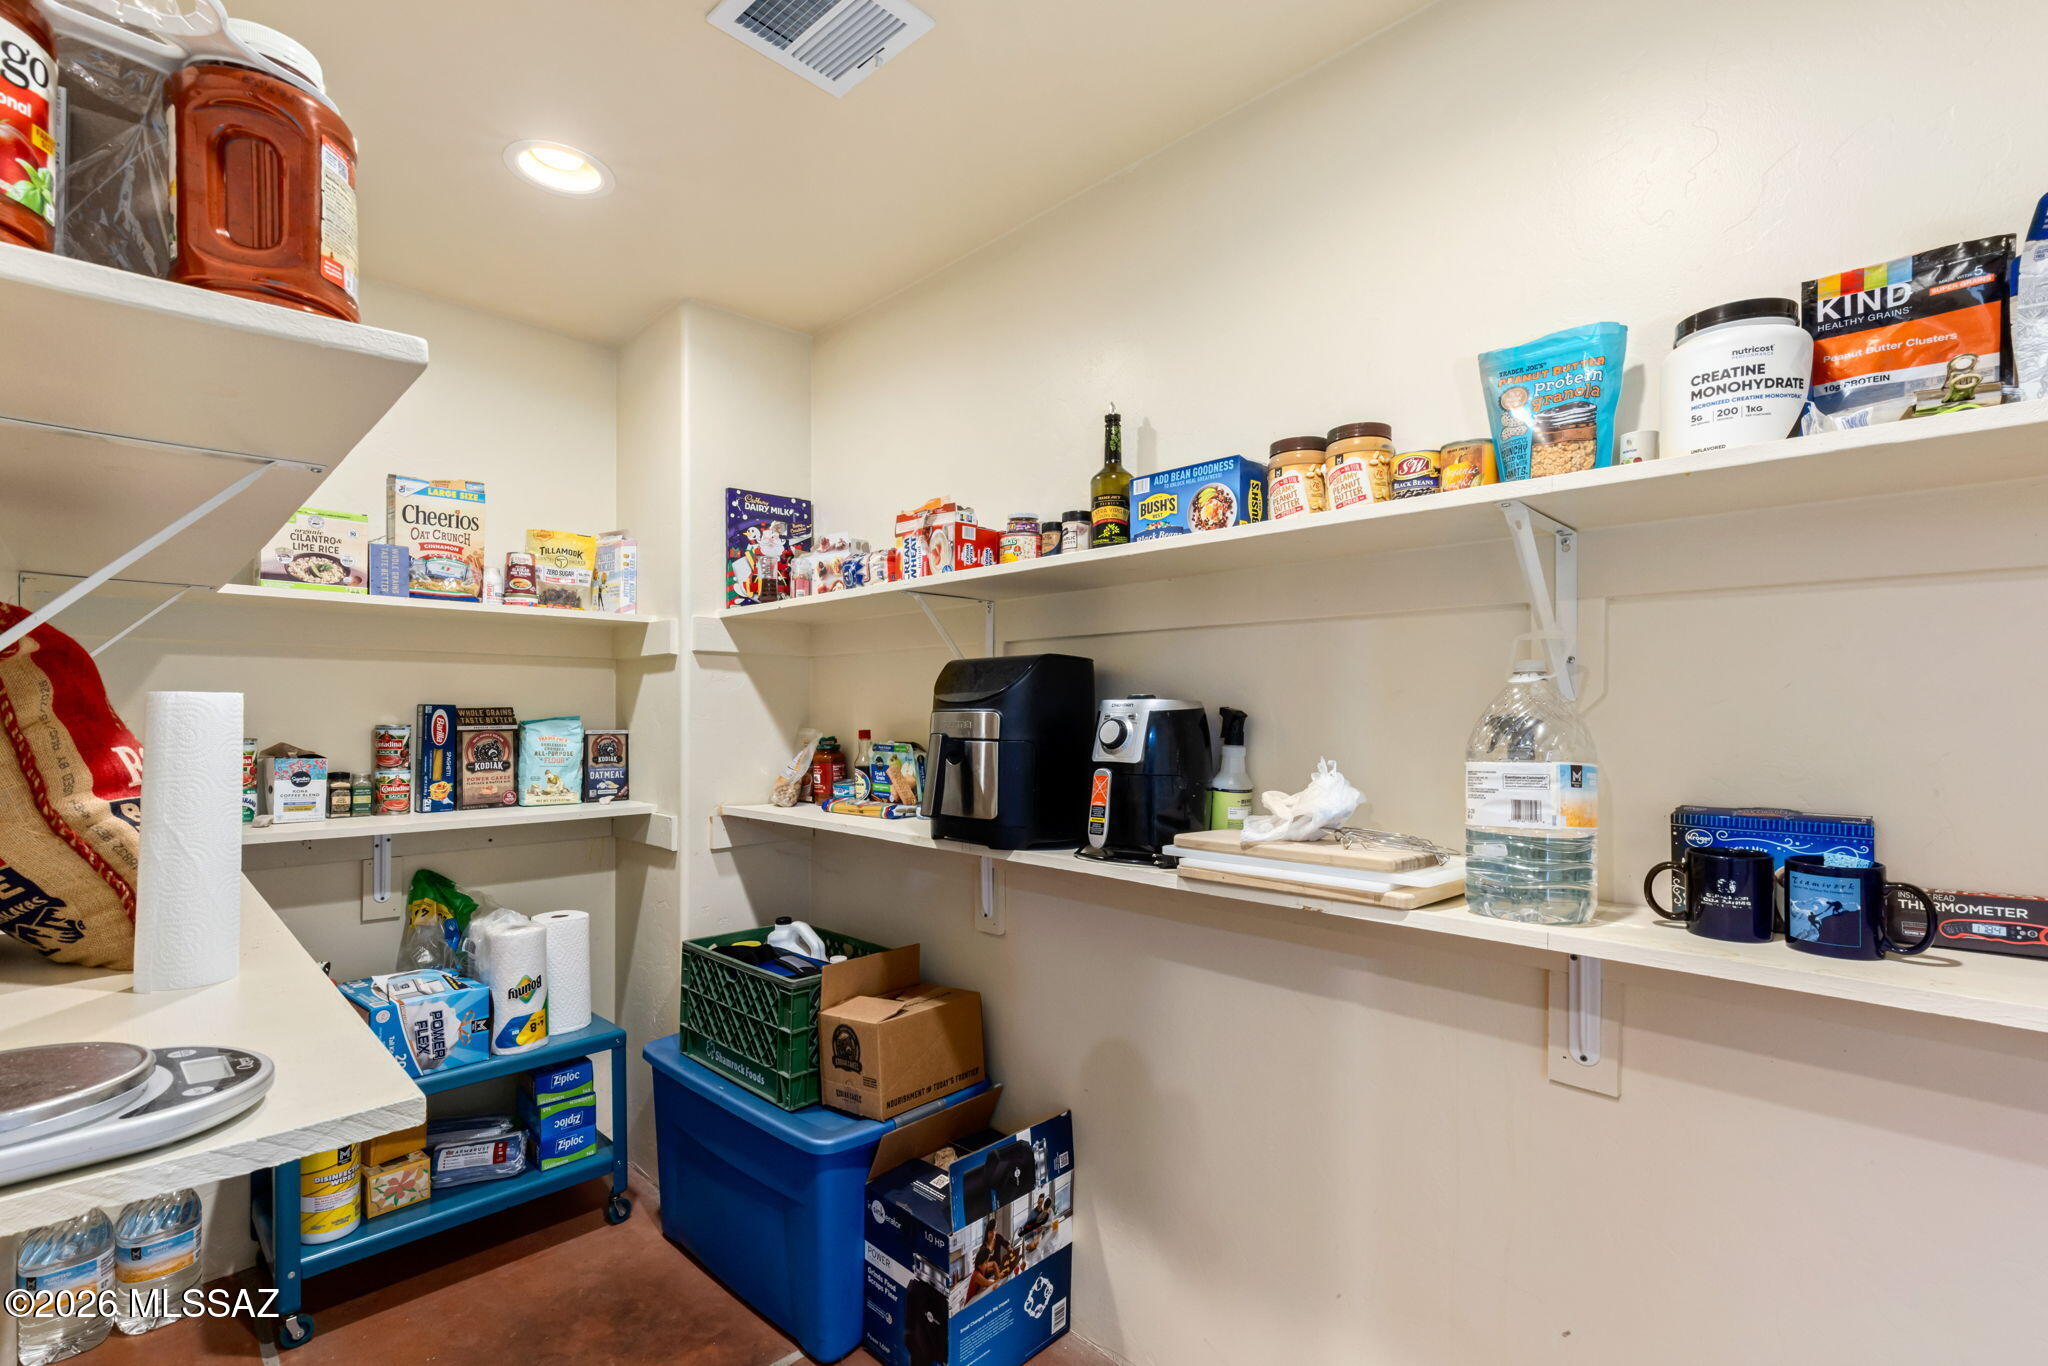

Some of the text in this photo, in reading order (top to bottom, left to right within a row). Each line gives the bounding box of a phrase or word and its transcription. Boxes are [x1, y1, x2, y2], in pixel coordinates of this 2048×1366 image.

[1, 40, 49, 89] go
[1973, 265, 1984, 276] 5
[1931, 275, 1993, 294] SUPER GRAINS
[1817, 281, 1912, 323] KIND
[1817, 307, 1911, 333] HEALTHY GRAINS
[1731, 345, 1774, 356] nutricost
[1865, 342, 1903, 355] Butter
[1905, 332, 1958, 348] Clusters
[1497, 356, 1606, 388] PEANUT BUTTER
[1498, 367, 1525, 379] TRADER
[1690, 363, 1766, 387] CREATINE
[1533, 366, 1603, 398] protein
[1690, 377, 1804, 402] MONOHYDRATE
[1823, 375, 1891, 394] 10g PROTEIN
[1531, 383, 1601, 413] granola
[1690, 399, 1731, 411] MICRONIZED
[1731, 394, 1764, 403] CREATINE
[1716, 406, 1739, 418] 200
[1745, 405, 1763, 414] 1KG
[1690, 415, 1703, 423] 5G
[1690, 444, 1727, 455] UNFLAVORED
[1153, 459, 1234, 486] ADD BEAN GOODNESS
[1332, 478, 1361, 495] PEANUT
[1393, 481, 1411, 489] BLACK
[428, 487, 479, 501] LARGE SIZE
[1272, 491, 1298, 506] PEANUT
[1334, 486, 1364, 504] BUTTER
[744, 502, 791, 516] DAIRY MILK
[1140, 497, 1176, 518] BUSH'S
[1273, 498, 1300, 514] BUTTER
[402, 504, 480, 531] Cheerios
[289, 532, 336, 545] CILANTRO
[294, 528, 323, 536] organic
[411, 527, 471, 546] OAT CRUNCH
[292, 542, 340, 555] LIME RICE
[424, 543, 459, 552] CINNAMON
[539, 546, 584, 560] TILLAMOOK
[546, 568, 574, 577] ZERO SUGAR
[458, 708, 484, 717] WHOLE
[485, 716, 514, 724] BETTER
[436, 717, 445, 743] Barilla
[474, 762, 504, 771] KODIAK
[598, 755, 618, 763] KODIAK
[590, 771, 624, 780] OATMEAL
[1687, 832, 1712, 844] Kroger
[1791, 875, 1856, 890] Teamwork
[1933, 894, 1955, 902] READ
[508, 974, 542, 999] Bounty
[415, 1020, 431, 1056] FLEX
[430, 1010, 446, 1061] POWER
[715, 1050, 765, 1086] Shamrock Foods
[553, 1071, 580, 1086] Ziploc
[886, 1087, 927, 1109] NOURISHMENT
[955, 1066, 980, 1082] FRONTIER
[553, 1114, 581, 1128] Ziploc
[557, 1135, 584, 1151] Ziploc
[340, 1147, 351, 1159] M
[924, 1231, 945, 1249] 1.0 HP
[867, 1245, 891, 1268] POWER
[867, 1266, 897, 1293] Grinds Food
[884, 1286, 899, 1302] Finer
